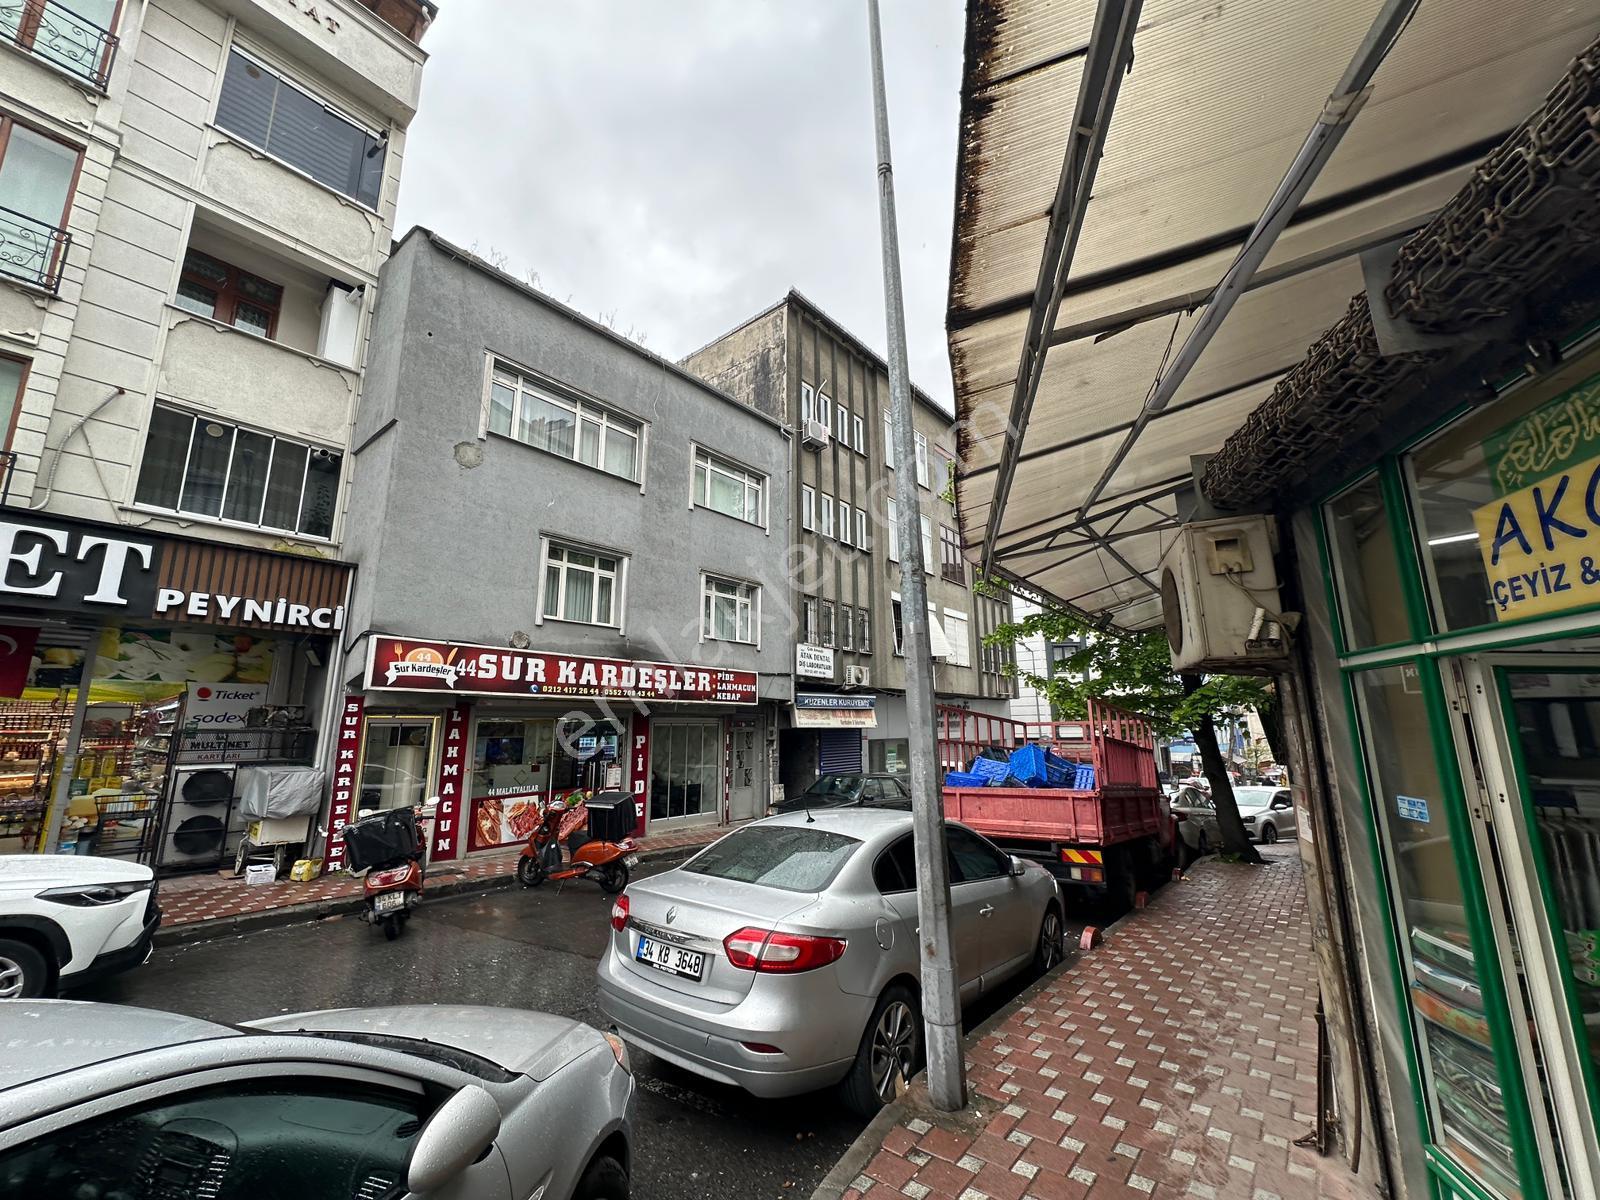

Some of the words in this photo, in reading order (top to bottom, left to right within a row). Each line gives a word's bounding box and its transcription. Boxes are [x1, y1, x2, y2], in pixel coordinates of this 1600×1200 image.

[288, 0, 341, 34] AT
[1492, 562, 1572, 611] ÇEYİZ
[155, 588, 345, 630] PEYNİRCİ
[416, 652, 432, 662] 44
[394, 663, 410, 673] Sur
[411, 663, 452, 676] Kardeşler
[456, 658, 477, 678] 44
[477, 653, 546, 683] SUR
[557, 660, 711, 694] KARDEŞLER
[717, 671, 735, 682] PİDE
[542, 685, 561, 693] 0212
[563, 686, 577, 694] 417
[717, 683, 757, 692] LAHMACUN
[215, 690, 256, 701] Ticket
[717, 692, 741, 701] KEBAP
[192, 711, 247, 724] sodex
[342, 703, 359, 739] SUR
[437, 710, 462, 852] LAHMACUN
[634, 735, 646, 817] PİDE
[487, 787, 495, 797] 44
[496, 784, 539, 796] MALATYALILAR
[643, 940, 654, 959] 34
[674, 950, 701, 974] 3648
